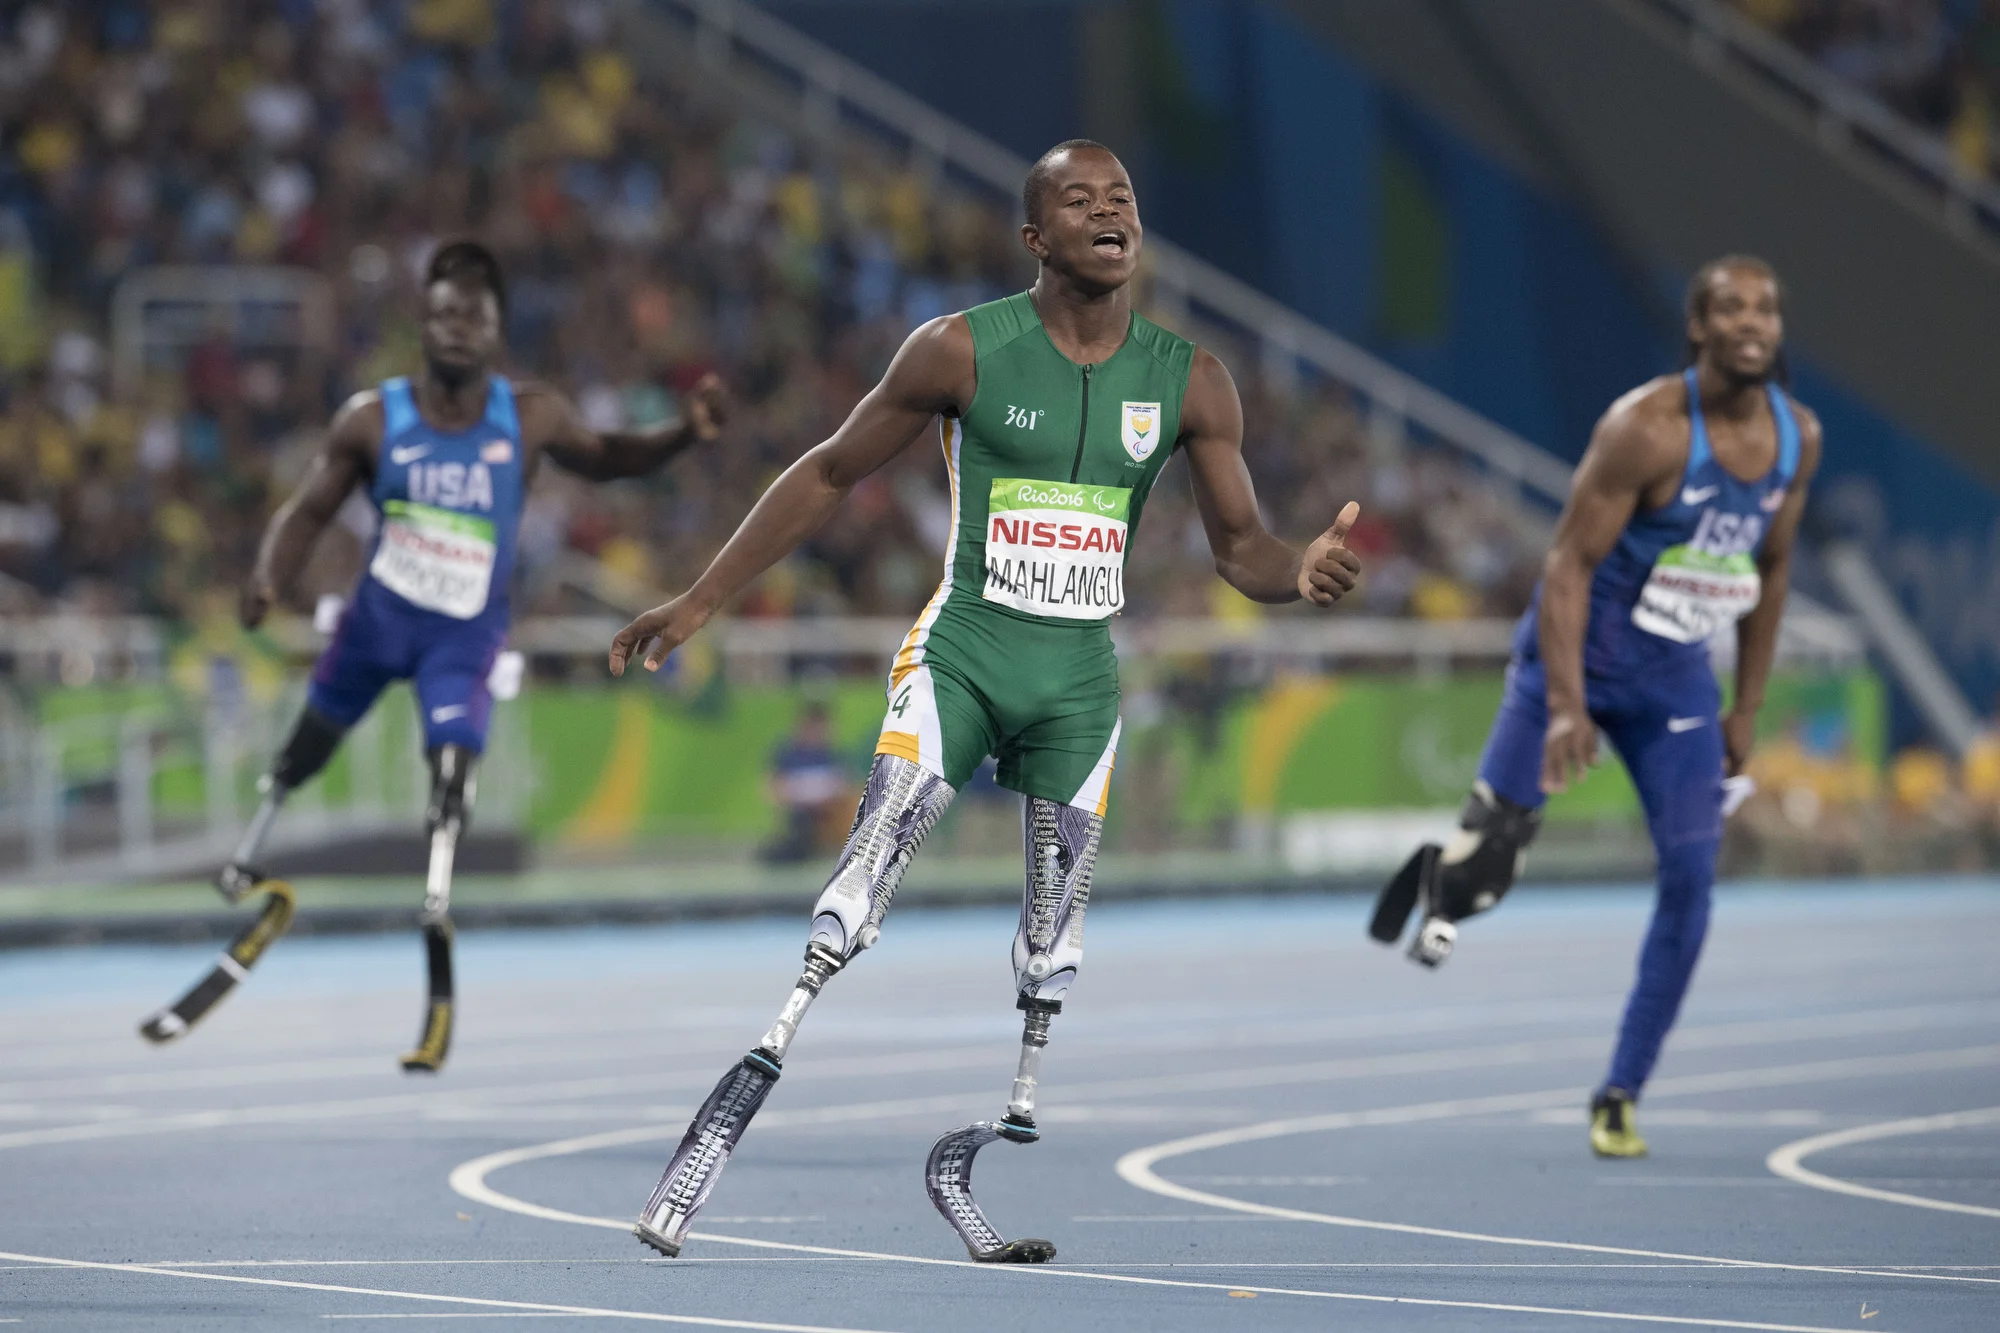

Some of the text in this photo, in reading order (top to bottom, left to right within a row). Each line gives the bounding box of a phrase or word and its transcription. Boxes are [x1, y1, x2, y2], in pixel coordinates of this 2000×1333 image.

[1004, 405, 1045, 430] 361°
[408, 461, 494, 512] USA
[991, 518, 1127, 553] NISSAN
[990, 556, 1121, 608] MAHLANGU
[892, 684, 912, 719] 4
[1035, 806, 1055, 814] Kathy
